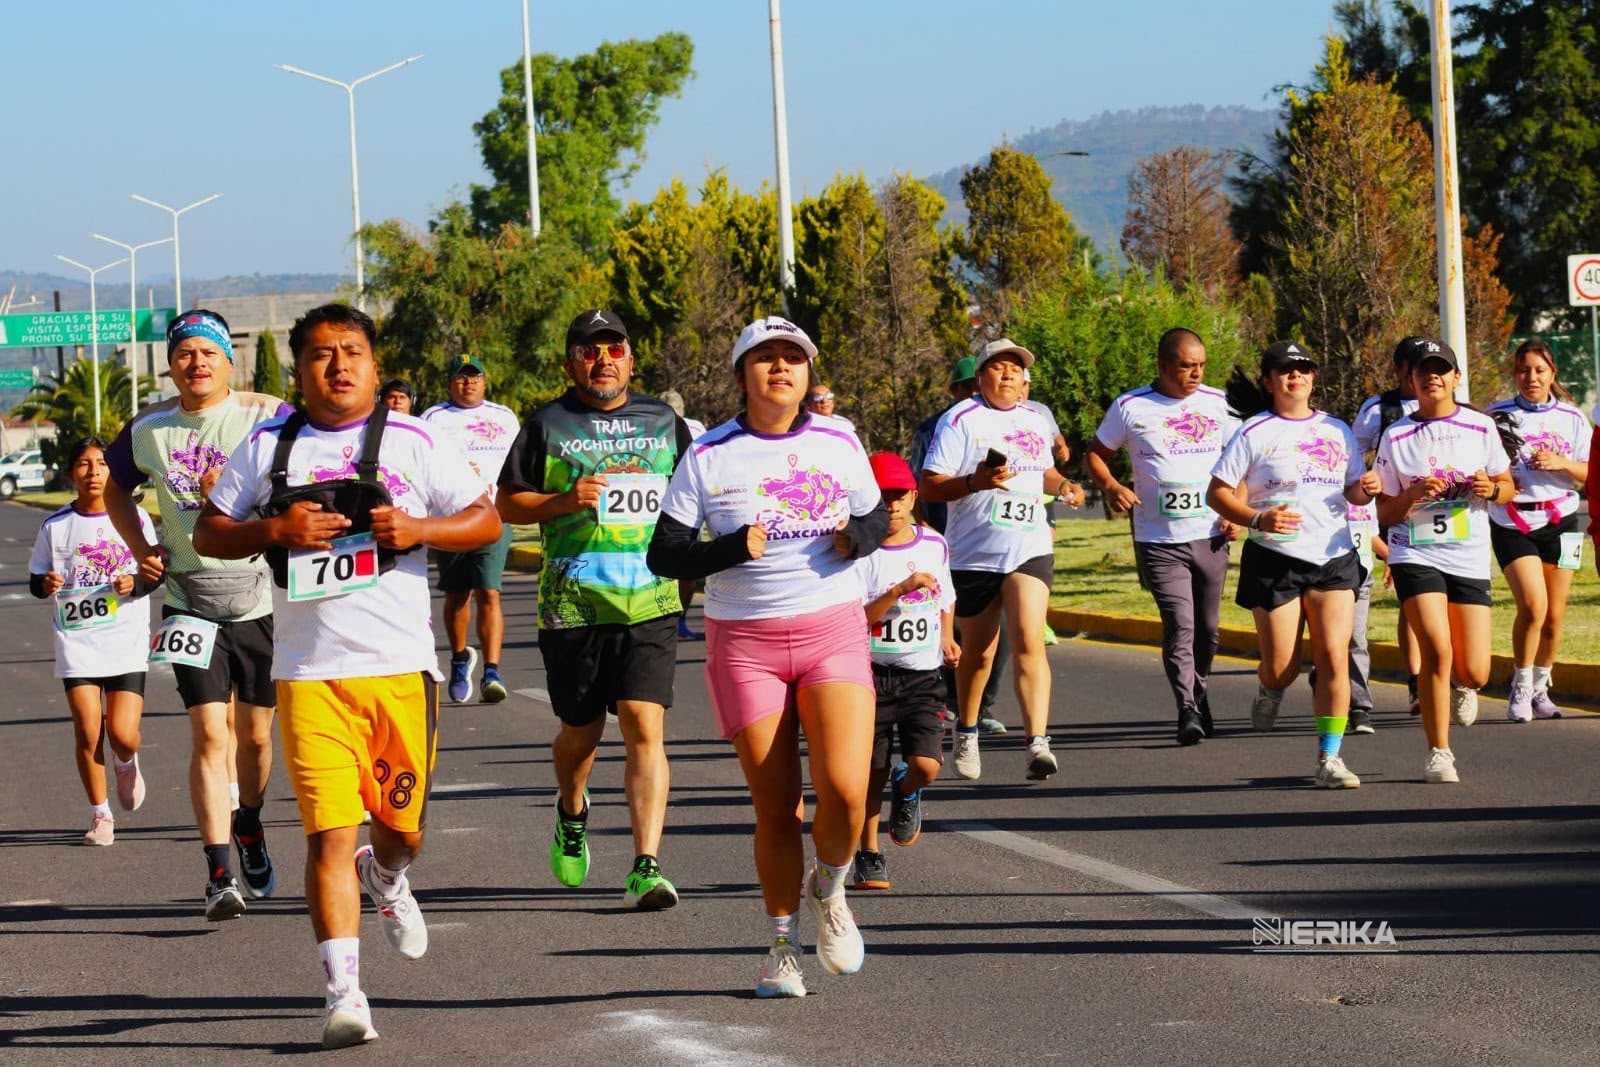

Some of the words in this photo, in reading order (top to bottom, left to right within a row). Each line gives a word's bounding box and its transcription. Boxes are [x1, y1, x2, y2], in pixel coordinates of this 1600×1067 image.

[26, 324, 60, 334] VISITA
[32, 314, 79, 325] GRACIAS
[112, 312, 125, 322] SU
[21, 334, 63, 343] PRONTO
[69, 333, 83, 342] SU
[88, 330, 131, 341] REGRES
[592, 419, 637, 435] TRAIL
[607, 489, 660, 514] 206
[1164, 491, 1202, 510] 231
[1000, 501, 1035, 523] 131
[1433, 514, 1447, 534] 5
[311, 553, 355, 585] 70
[65, 597, 109, 621] 266
[881, 617, 928, 643] 169
[157, 629, 204, 656] 168
